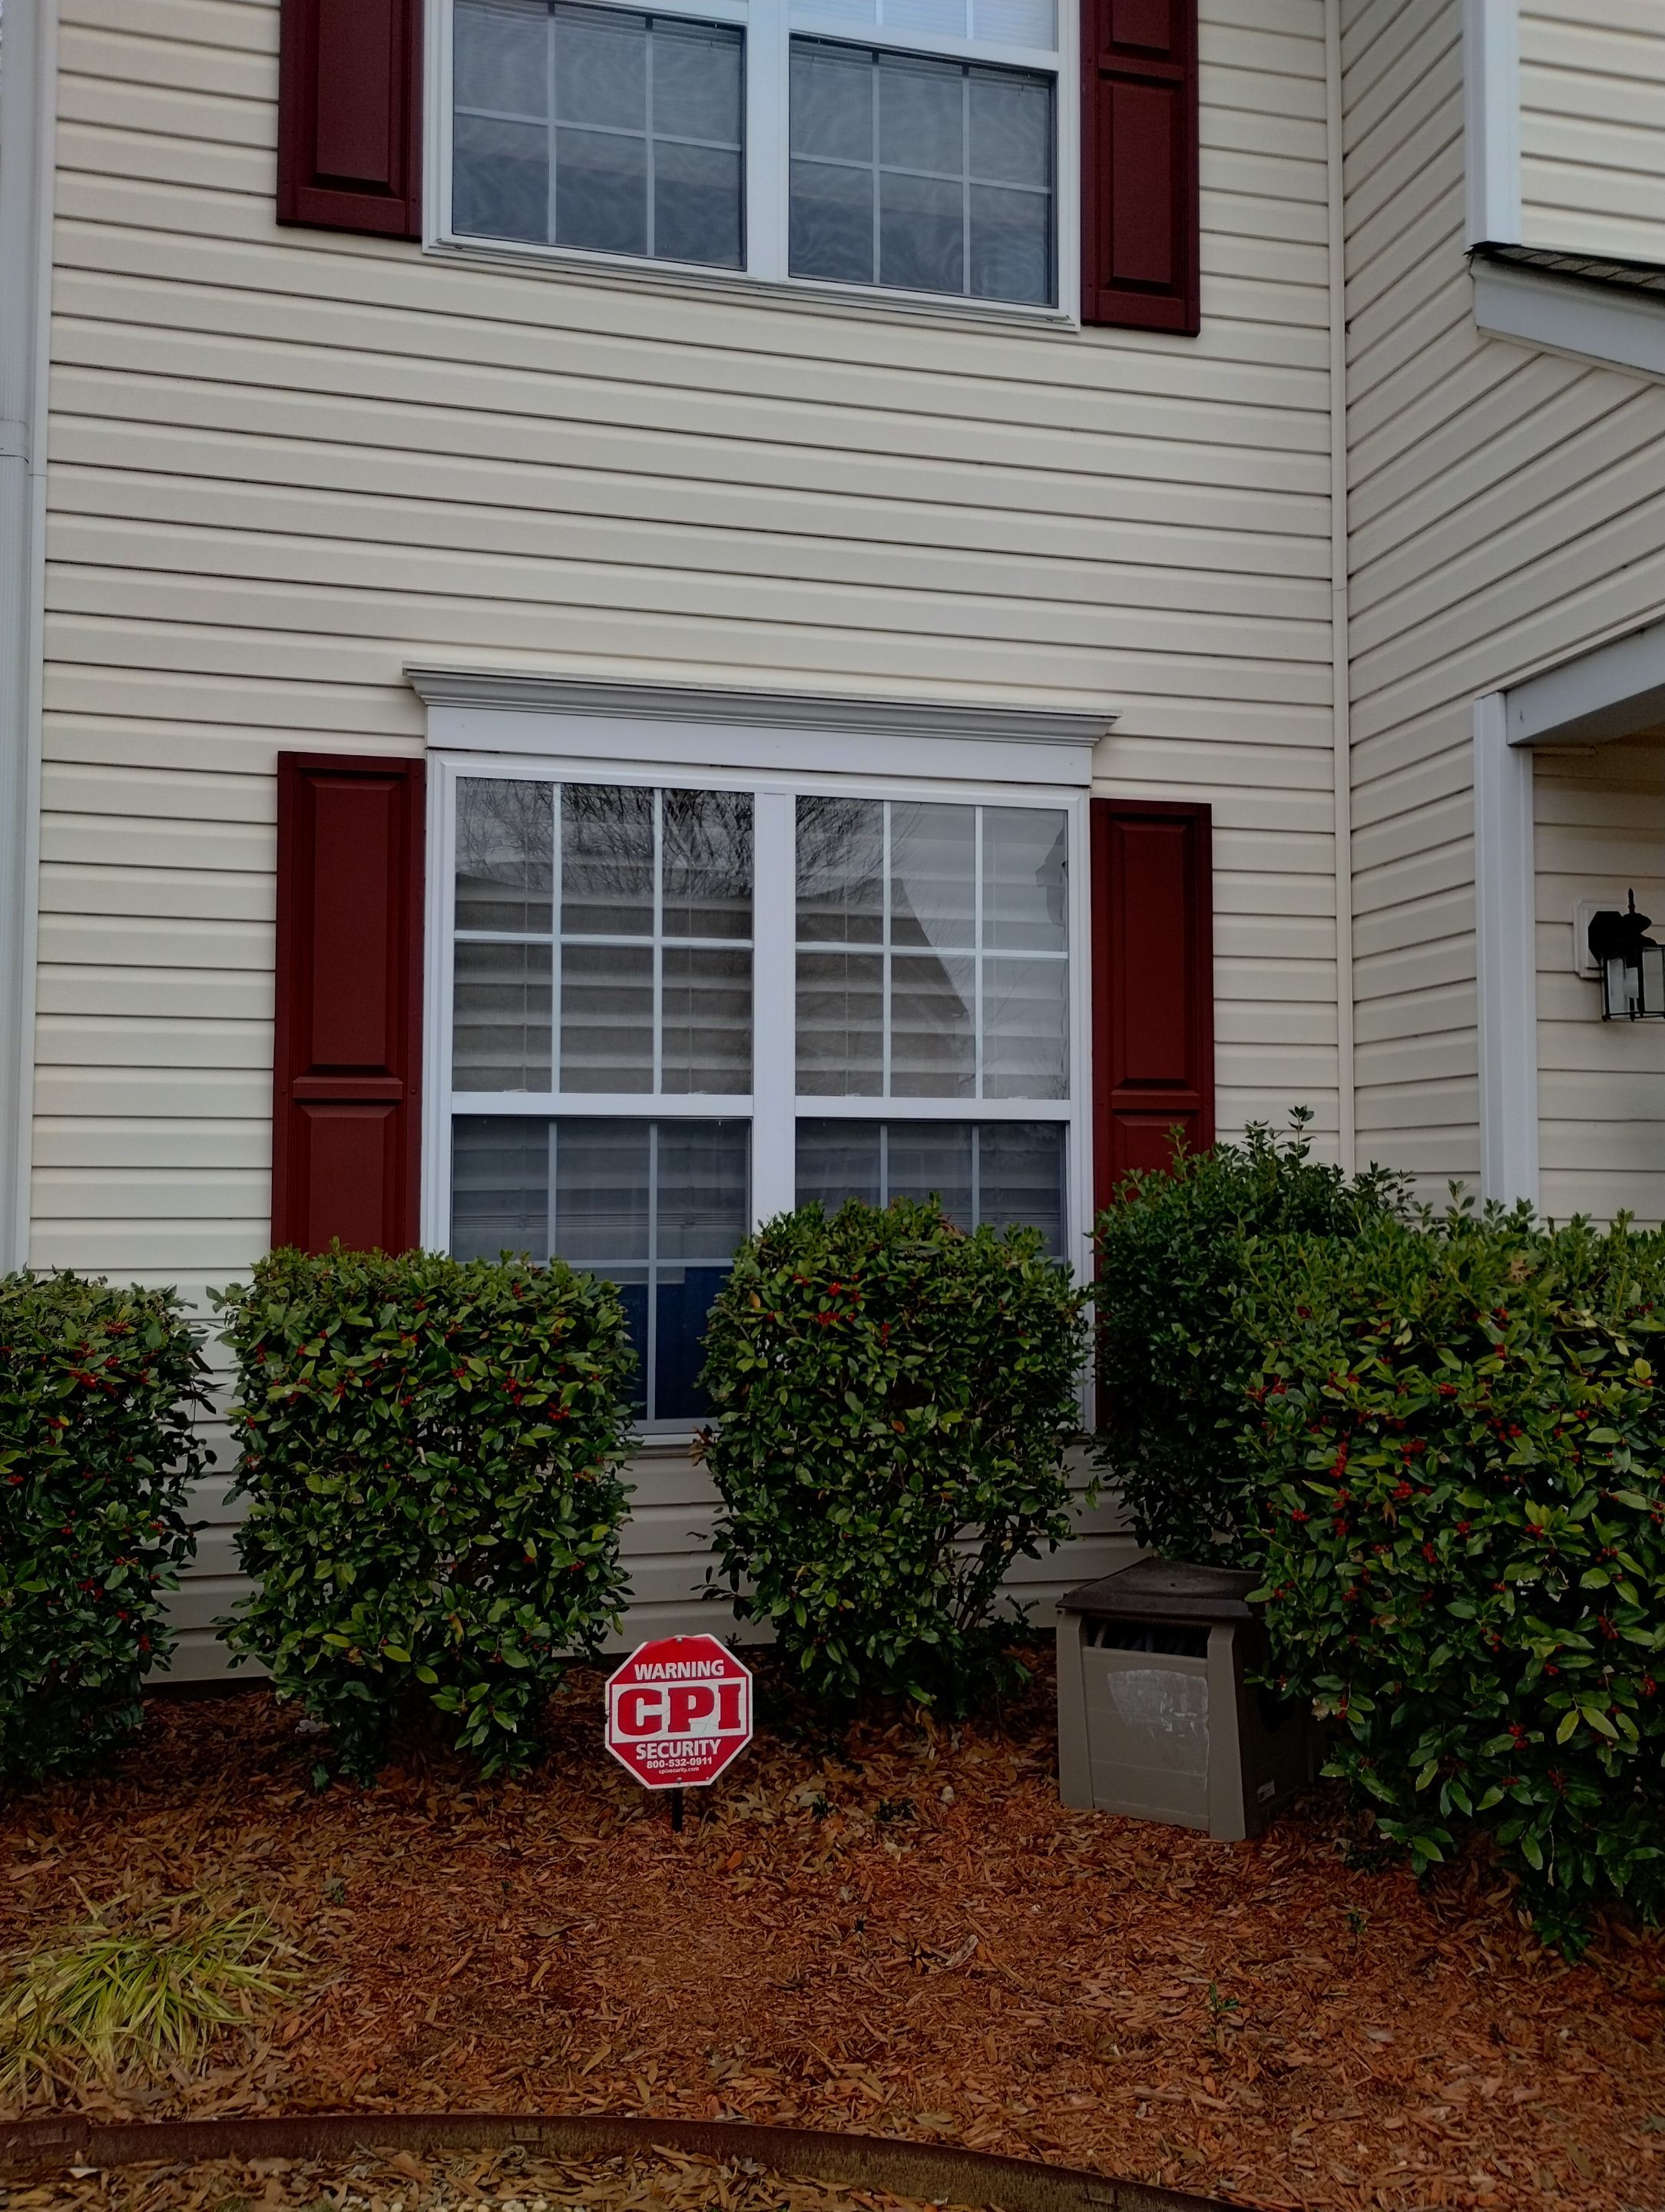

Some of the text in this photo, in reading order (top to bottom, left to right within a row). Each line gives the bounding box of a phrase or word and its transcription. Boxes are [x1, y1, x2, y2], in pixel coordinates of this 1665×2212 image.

[634, 1659, 724, 1681] WARNING
[617, 1683, 741, 1736] CPI
[636, 1739, 722, 1760] SECURITY
[646, 1757, 712, 1769] 800-532-0911
